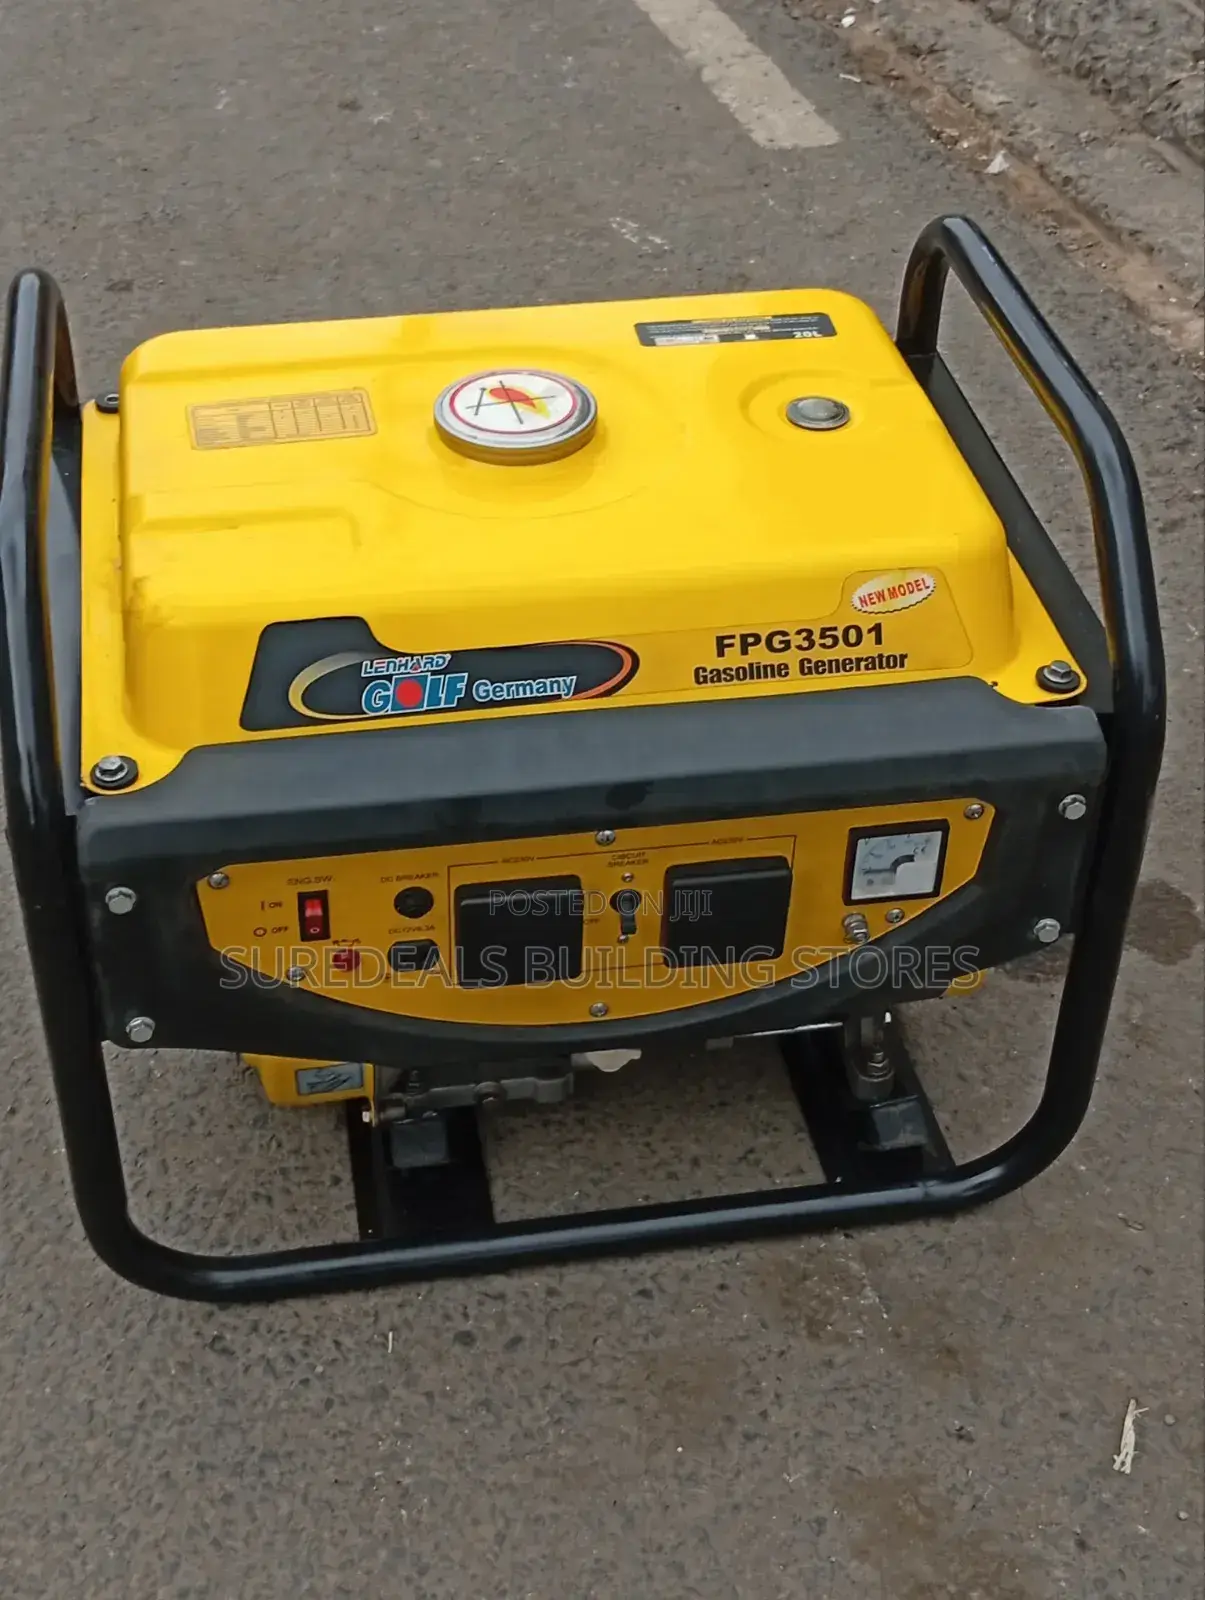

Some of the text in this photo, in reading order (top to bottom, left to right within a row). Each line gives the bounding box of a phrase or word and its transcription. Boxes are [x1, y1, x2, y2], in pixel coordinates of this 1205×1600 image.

[792, 330, 822, 338] 20L
[858, 577, 931, 608] NEW MODEL
[715, 622, 883, 657] FPG3501
[361, 653, 451, 677] LENHARD
[693, 652, 908, 684] Gasoline Generator
[362, 673, 577, 714] GOLF Germany
[268, 901, 283, 909] ON
[271, 925, 289, 934] OFF
